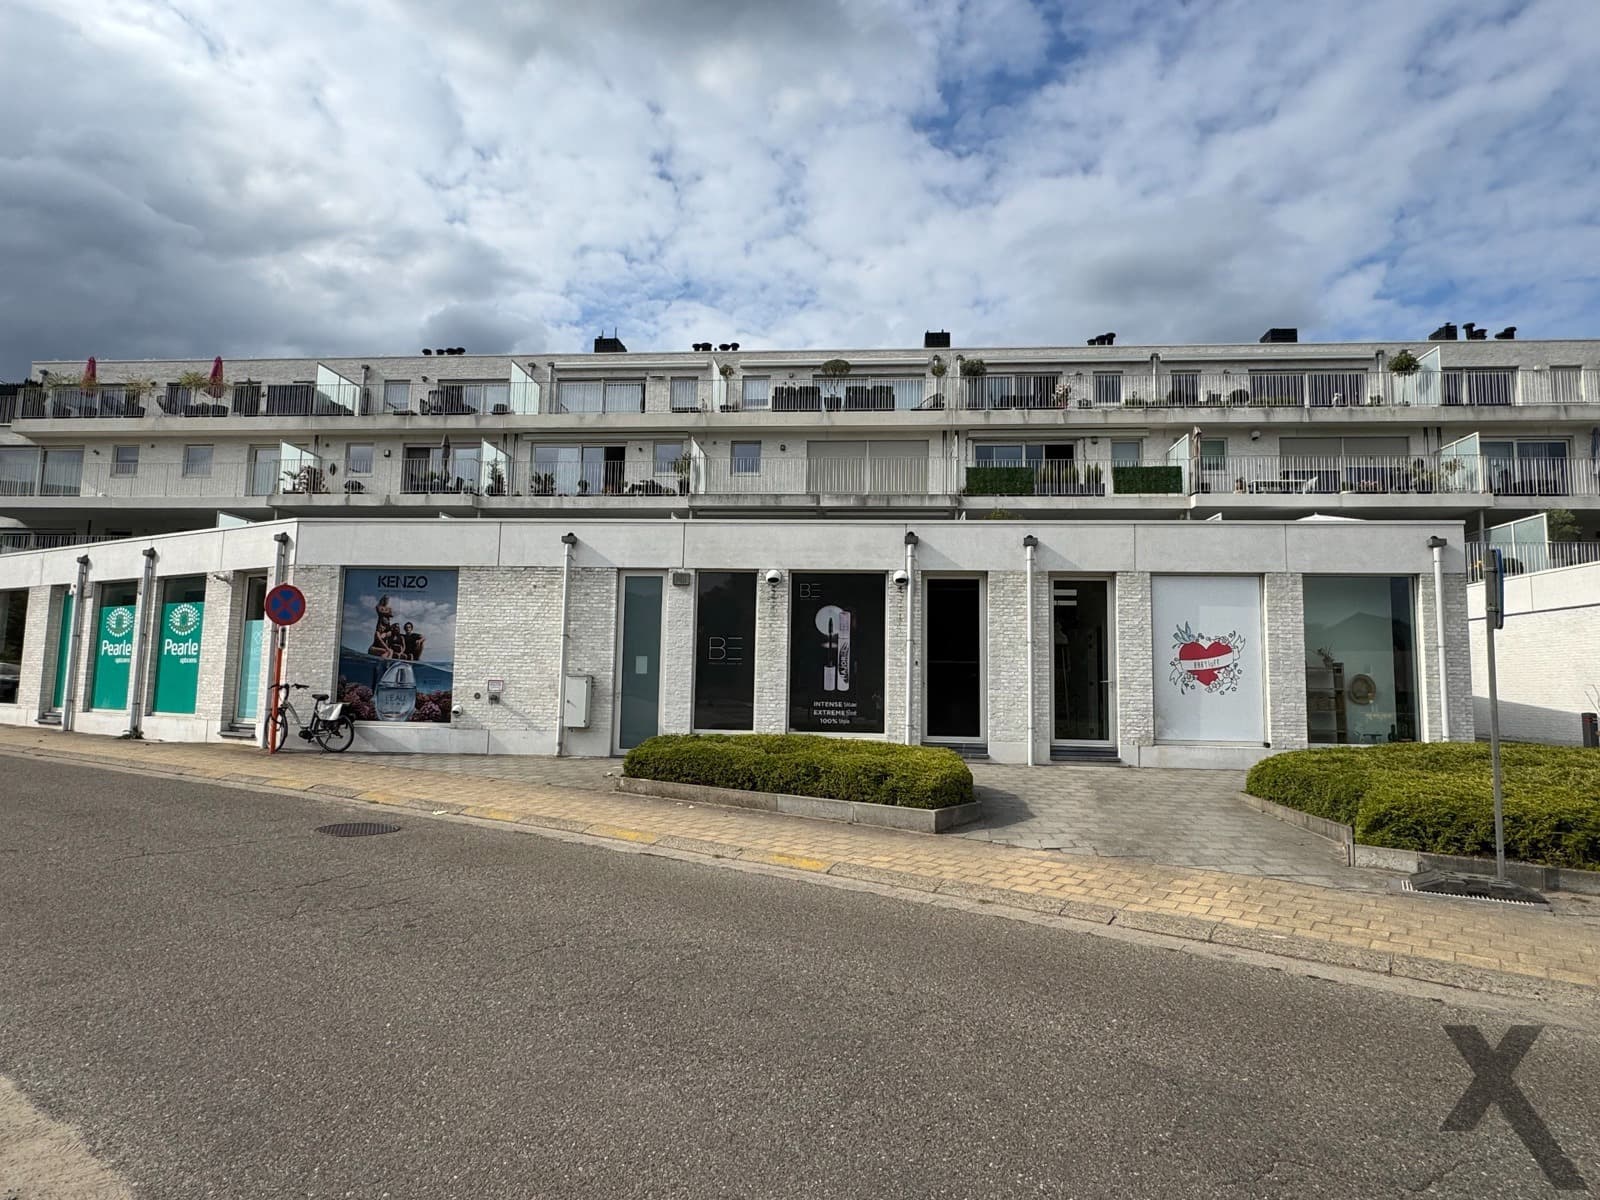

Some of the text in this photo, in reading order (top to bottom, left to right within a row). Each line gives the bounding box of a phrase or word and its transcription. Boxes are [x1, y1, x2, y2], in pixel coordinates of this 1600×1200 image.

[378, 576, 428, 588] KENZO
[101, 639, 132, 656] Pearle
[163, 638, 199, 656] Pearle
[708, 636, 743, 661] BE
